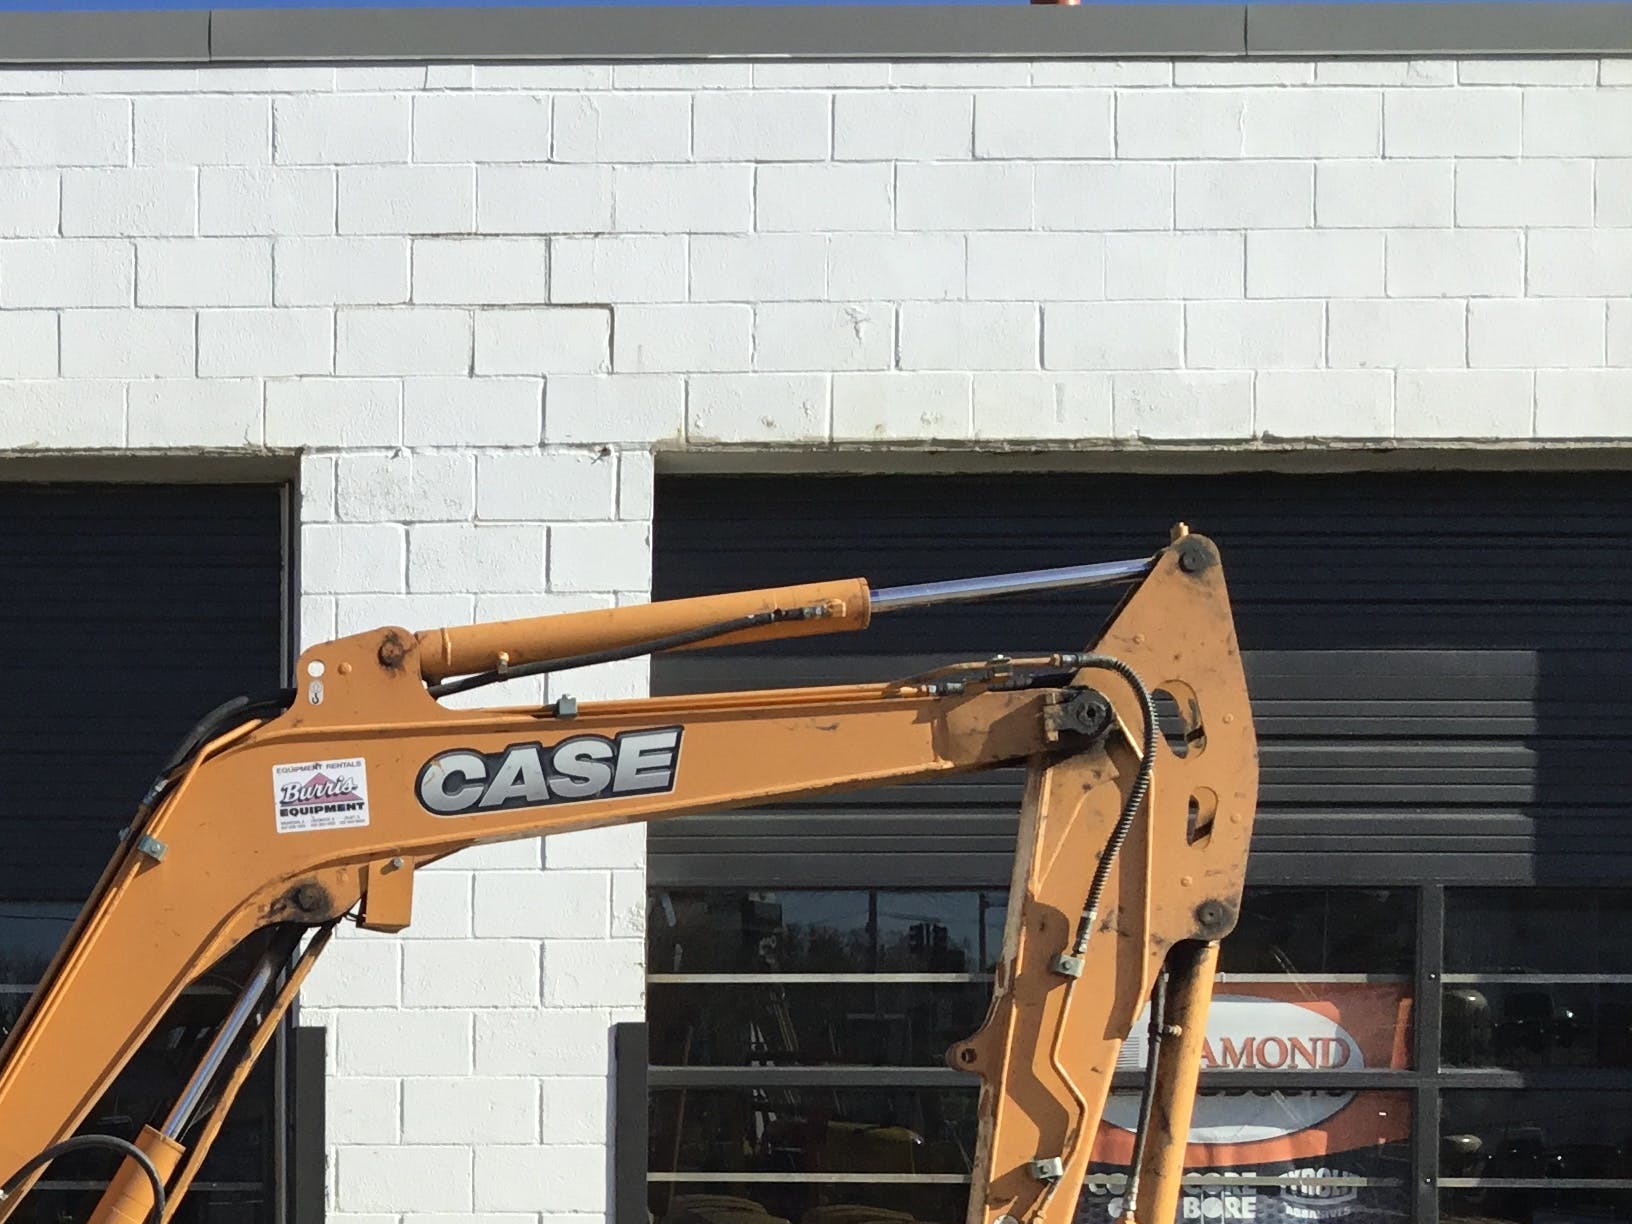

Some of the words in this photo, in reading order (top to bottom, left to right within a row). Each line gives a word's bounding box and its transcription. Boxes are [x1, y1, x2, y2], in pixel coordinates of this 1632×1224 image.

[276, 763, 323, 774] EQUIPMENT
[326, 760, 362, 769] RENTALS
[418, 729, 680, 813] CASE
[279, 775, 358, 804] Burris
[279, 802, 364, 817] EQUIPMENT
[1200, 1036, 1351, 1069] AMOND
[1183, 1196, 1257, 1219] BORE
